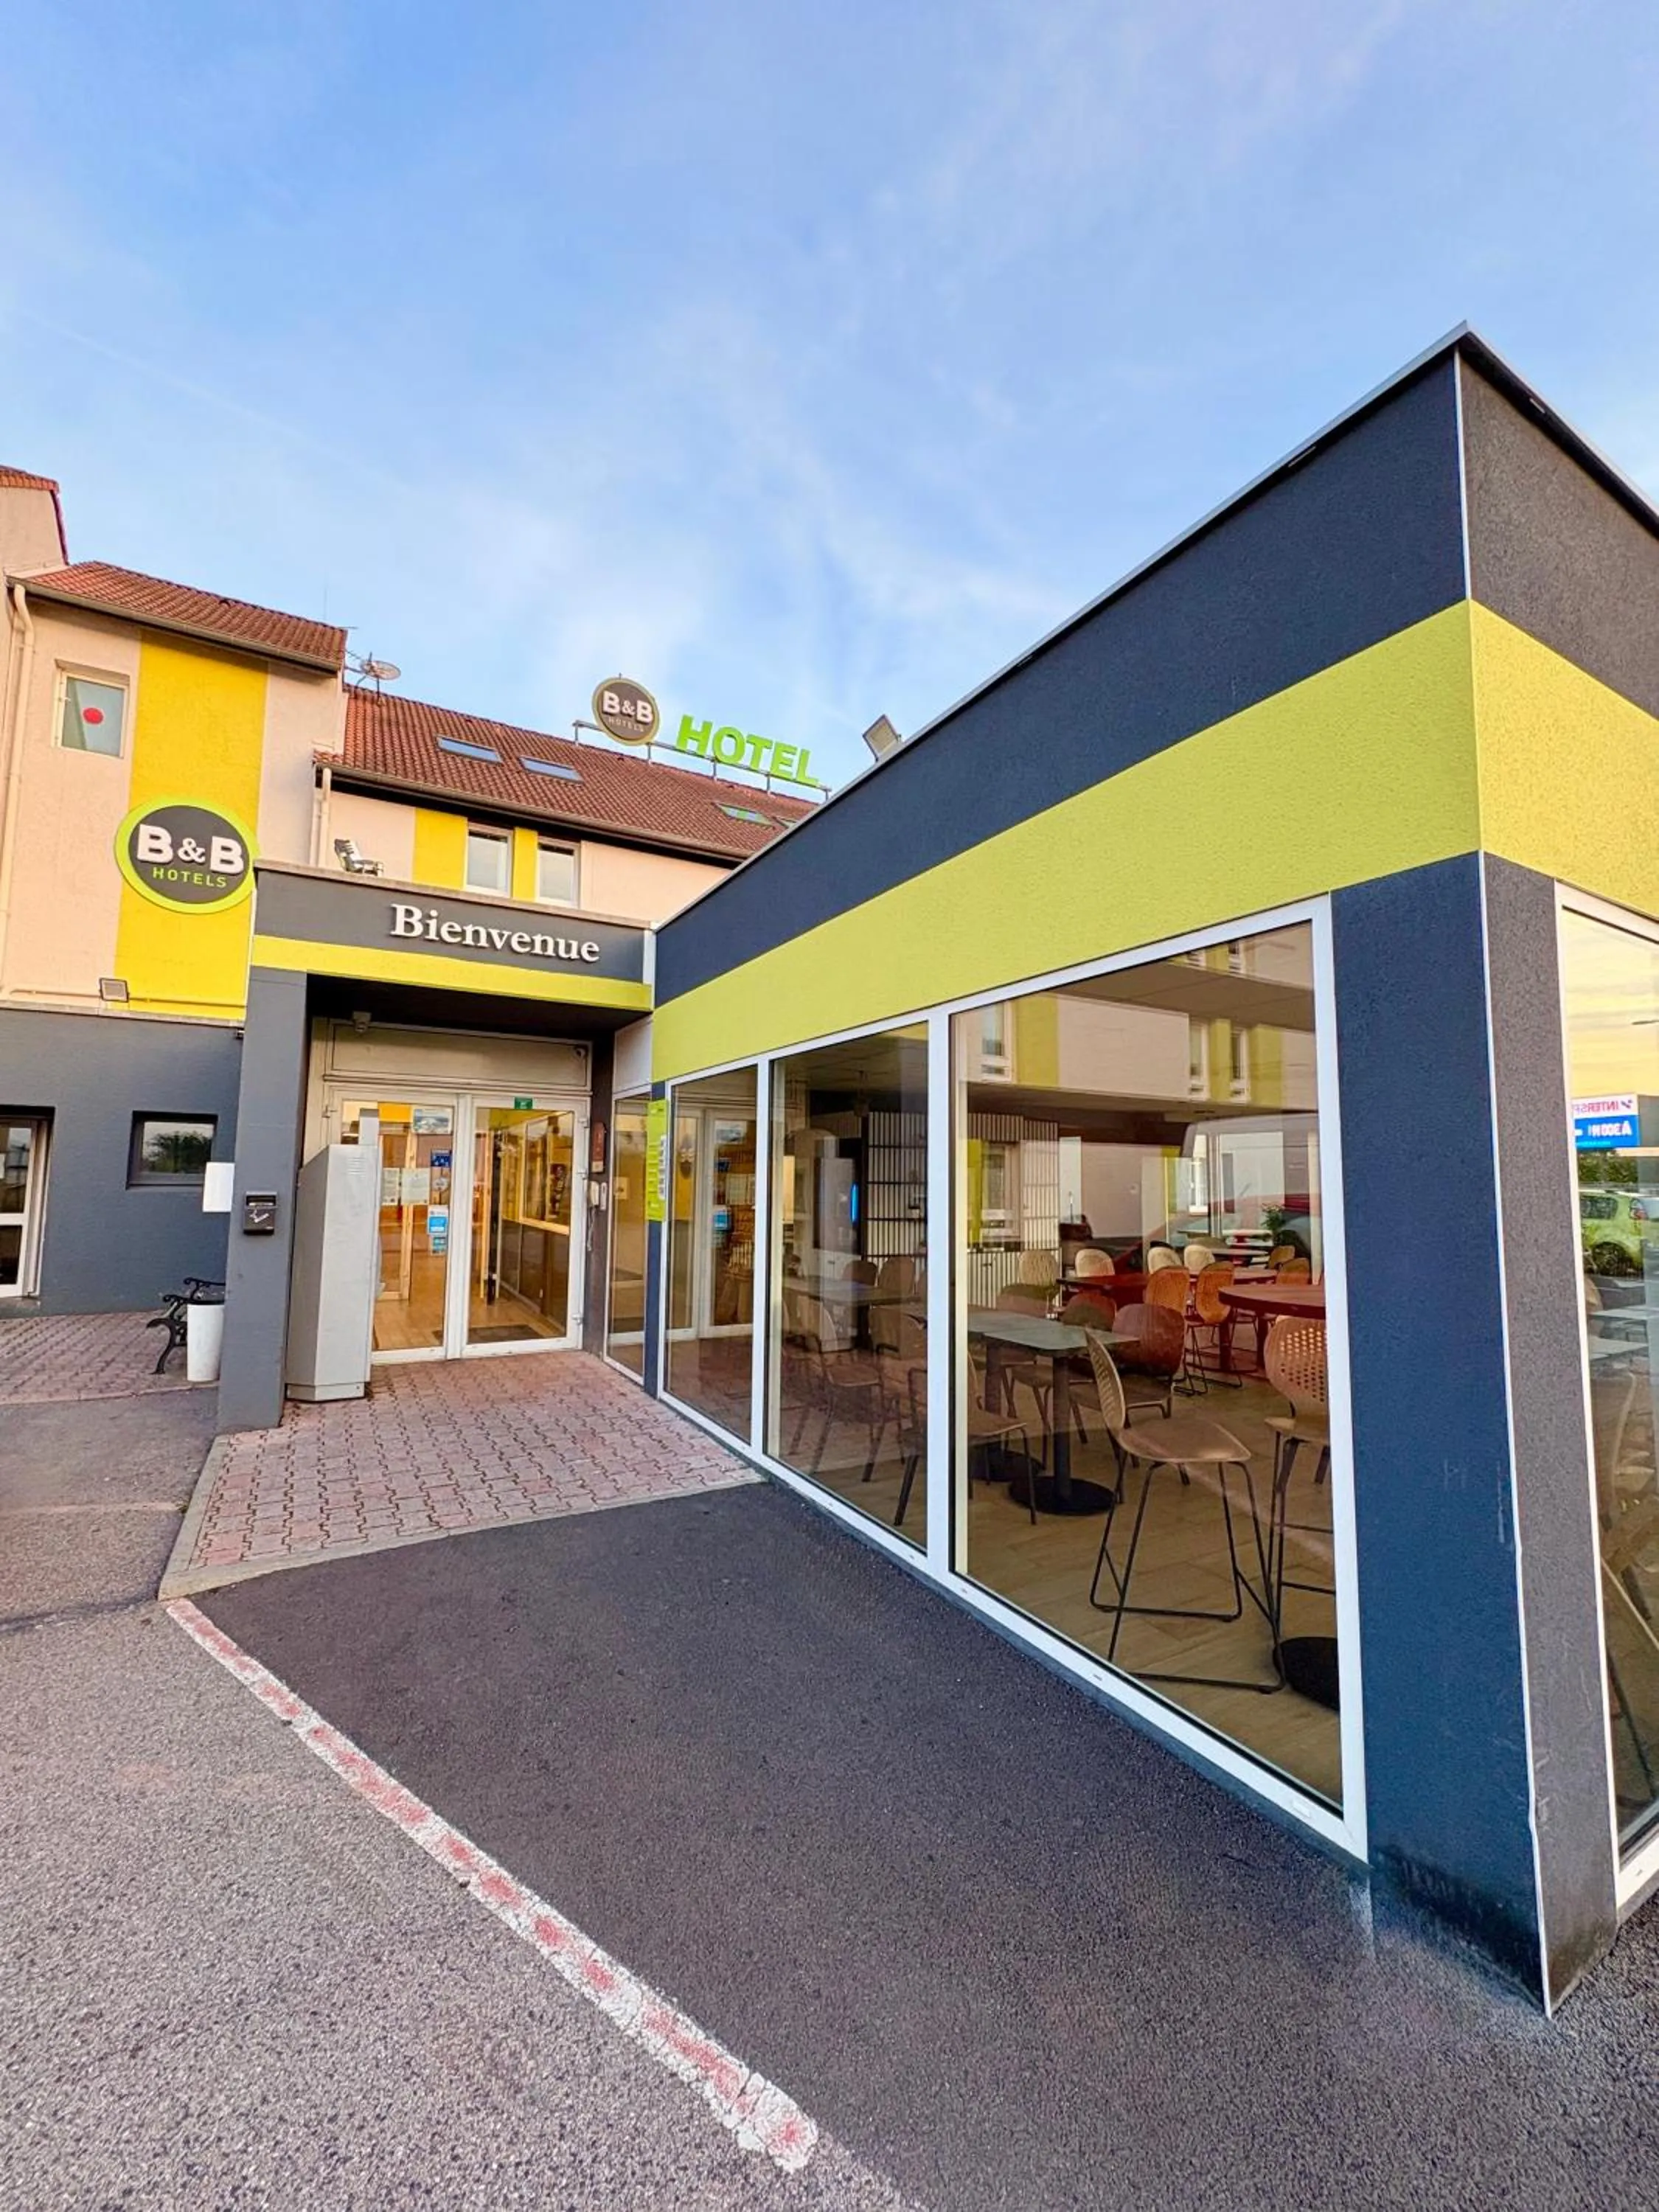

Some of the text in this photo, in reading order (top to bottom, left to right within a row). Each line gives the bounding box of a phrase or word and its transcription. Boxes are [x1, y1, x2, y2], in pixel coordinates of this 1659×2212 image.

[603, 690, 653, 723] B&B
[675, 714, 819, 787] HOTEL
[136, 824, 244, 874] B&B
[153, 866, 227, 888] HOTELS
[390, 903, 599, 962] Bienvenue
